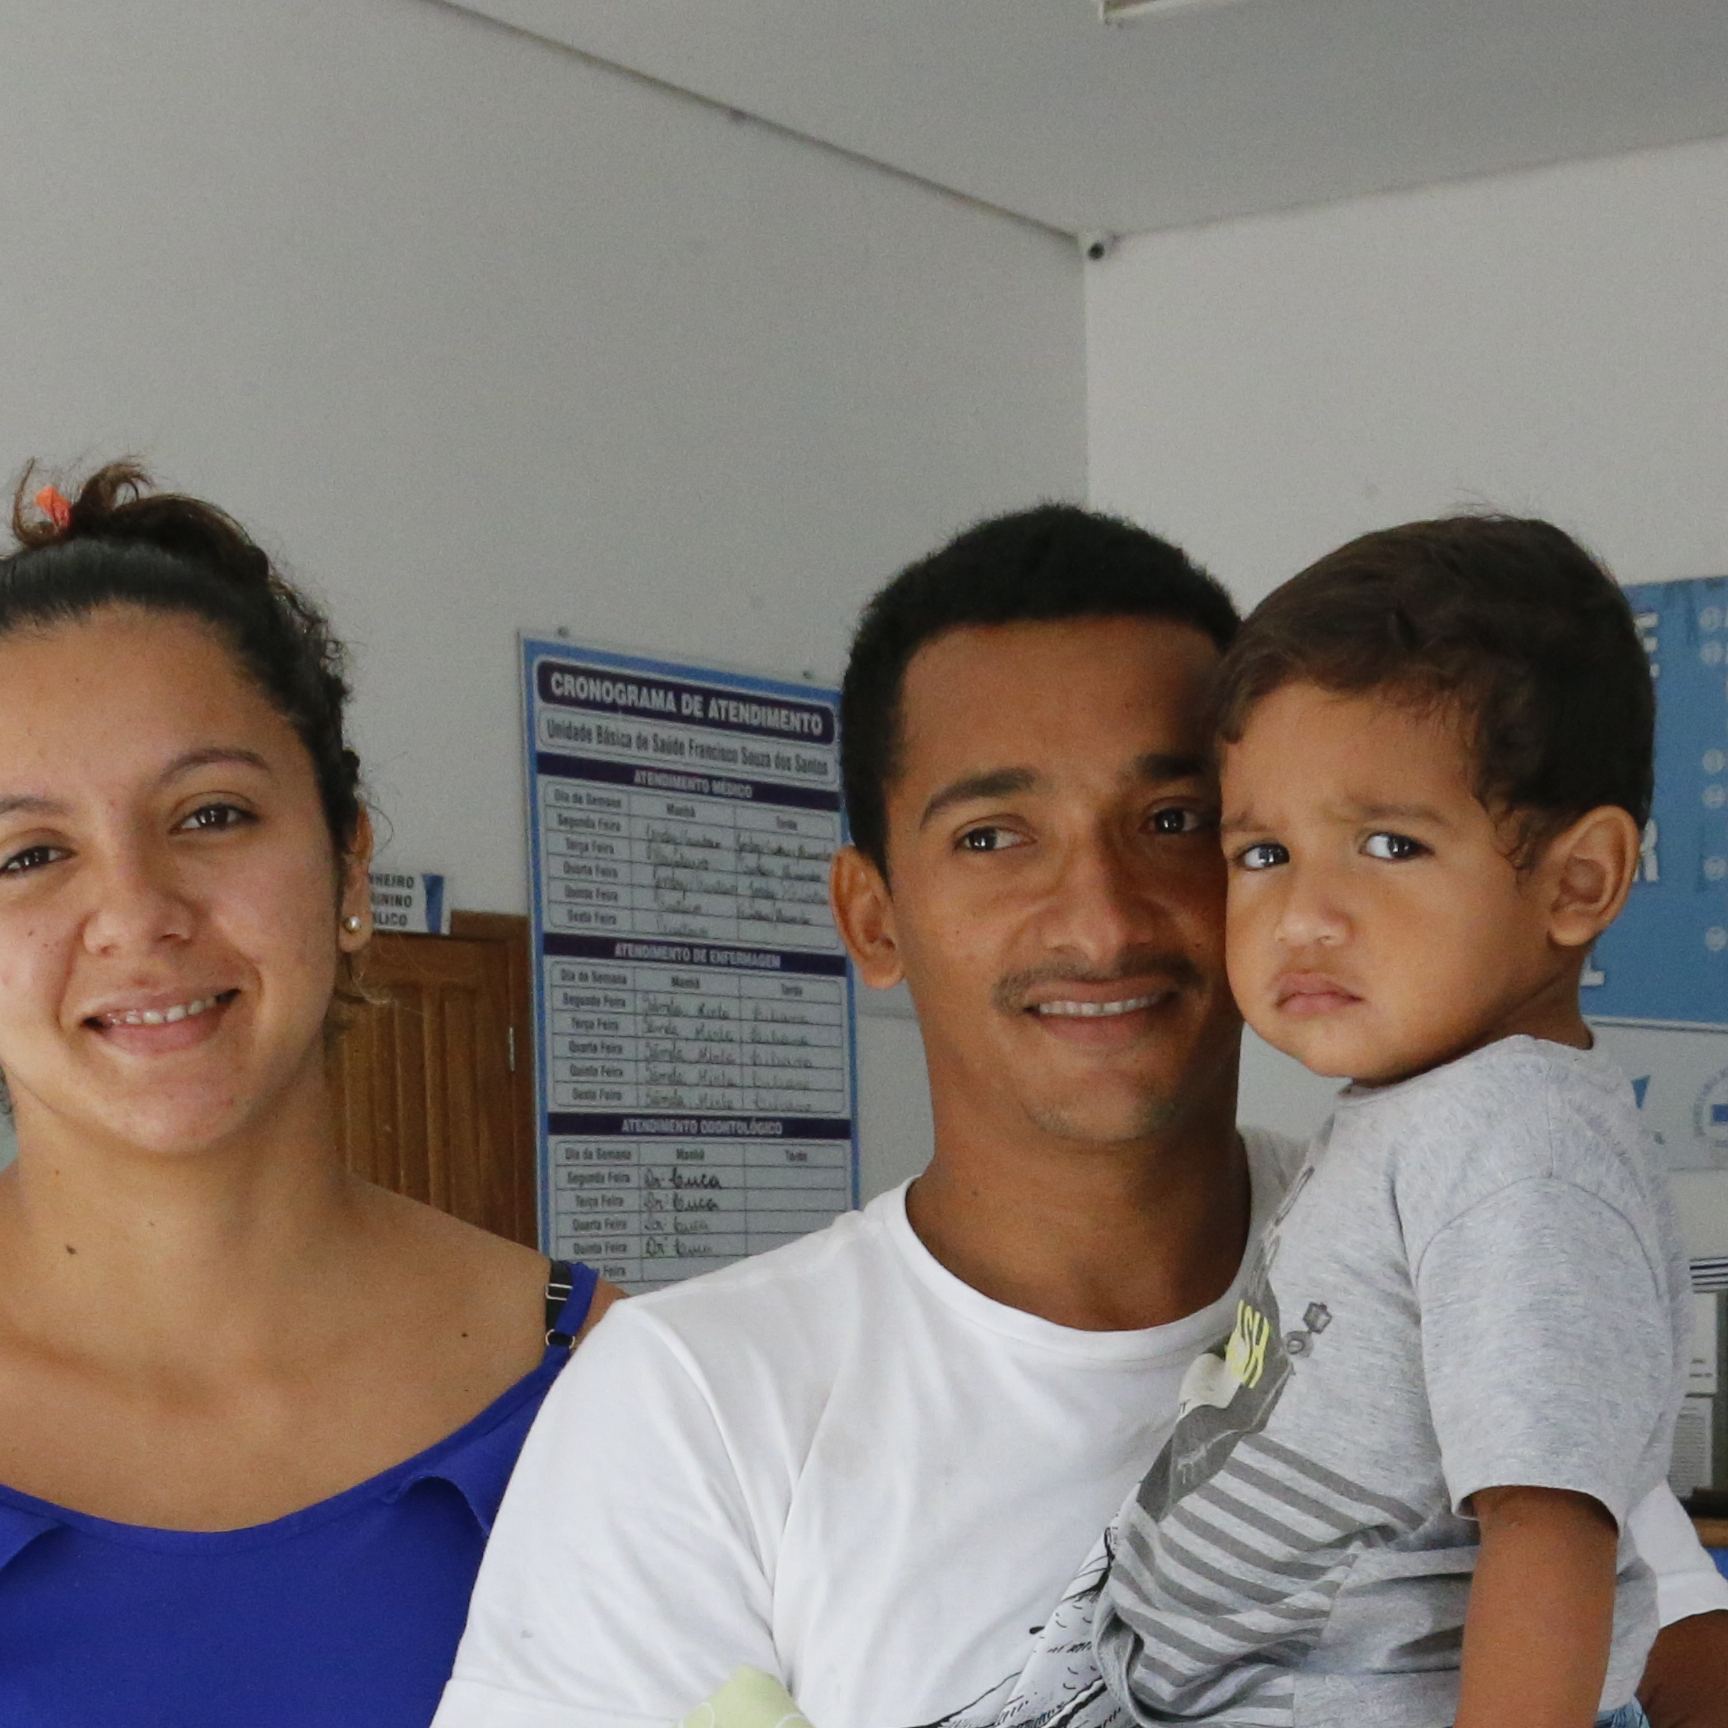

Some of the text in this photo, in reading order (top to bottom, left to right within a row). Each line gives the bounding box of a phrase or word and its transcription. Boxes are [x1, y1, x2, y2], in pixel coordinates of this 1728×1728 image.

[550, 671, 824, 737] CRONOGRAMA DE ATENDIMENTO
[635, 731, 649, 751] de
[622, 1118, 698, 1135] ATENDIMENTO
